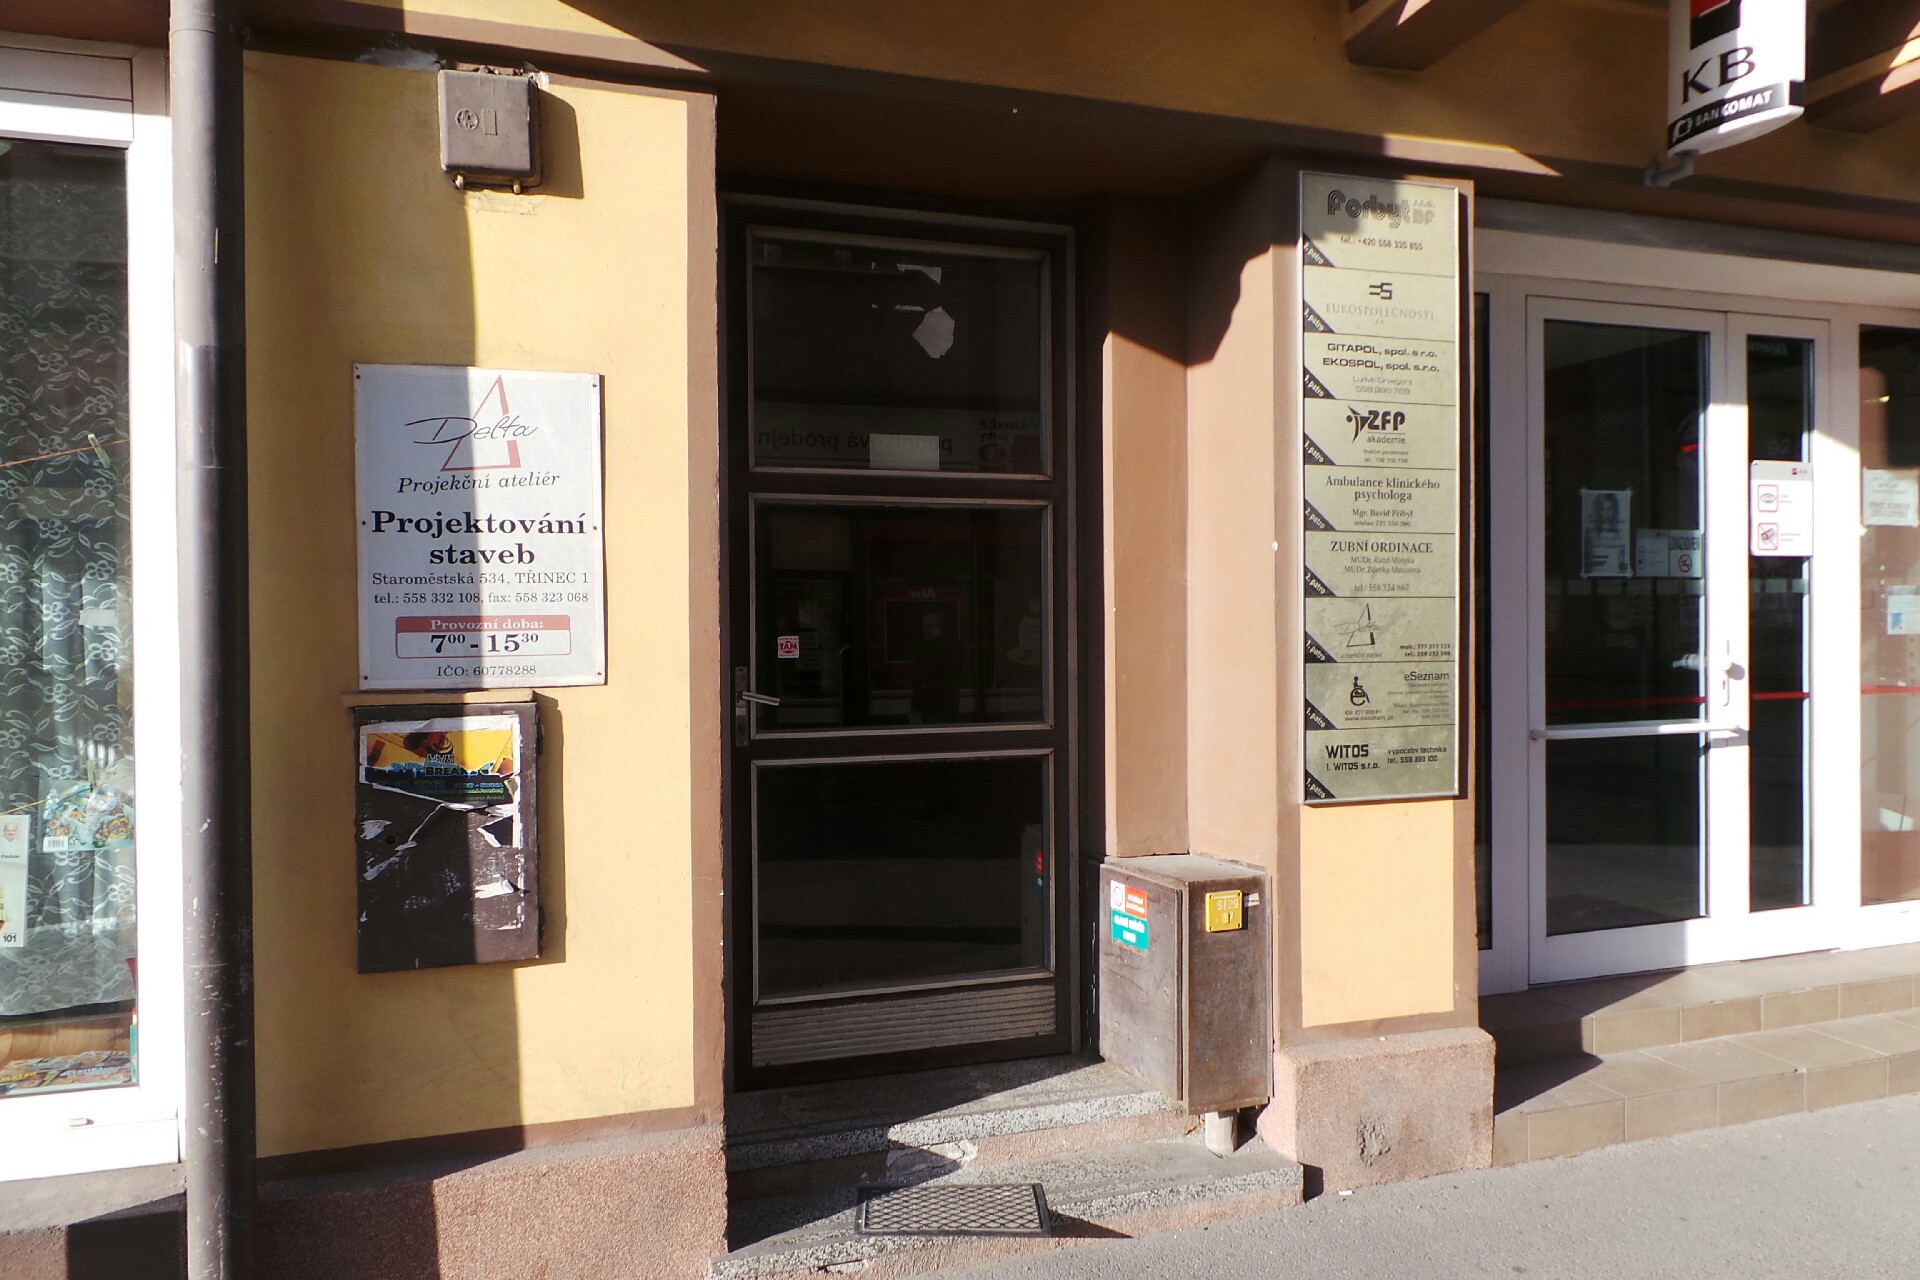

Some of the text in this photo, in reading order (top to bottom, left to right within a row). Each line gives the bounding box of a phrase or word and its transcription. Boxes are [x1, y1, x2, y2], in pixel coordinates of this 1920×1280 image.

[1682, 46, 1755, 104] KB
[1308, 248, 1323, 264] patro
[1326, 304, 1434, 320] EUROSPOLEČNOSTI
[1308, 314, 1324, 330] patro
[1328, 343, 1382, 355] GITAPOL,
[1384, 348, 1410, 356] spol.
[1323, 358, 1383, 370] EKOSPOL,
[1386, 363, 1411, 372] spol.
[1308, 380, 1324, 397] patro
[1368, 410, 1406, 431] ZFP
[404, 415, 539, 444] Delta
[1367, 435, 1406, 444] akademie
[1308, 447, 1324, 463] patro
[397, 471, 560, 494] Projekční ateliér
[1326, 475, 1440, 489] Ambulance klinického
[1355, 490, 1412, 503] psychologa
[372, 510, 586, 538] Projektování
[1308, 513, 1325, 529] patro
[430, 543, 535, 565] staveb
[1331, 540, 1433, 553] ZUBNÍ ORDINACE
[372, 572, 474, 585] Staroměstská
[515, 570, 576, 584] TŘINEC
[582, 572, 589, 584] 1
[1309, 578, 1325, 595] patro
[374, 592, 588, 605] tel.: 558 332 108, fax: 558 323 068
[431, 618, 544, 630] Provozní doba:
[1310, 646, 1326, 661] patro
[437, 665, 536, 676] IČO: 60778288
[1404, 671, 1449, 681] eSeznam
[1310, 712, 1325, 728] patro
[1325, 744, 1369, 758] WITOS
[1334, 762, 1358, 770] WITOS
[1310, 783, 1326, 799] patro
